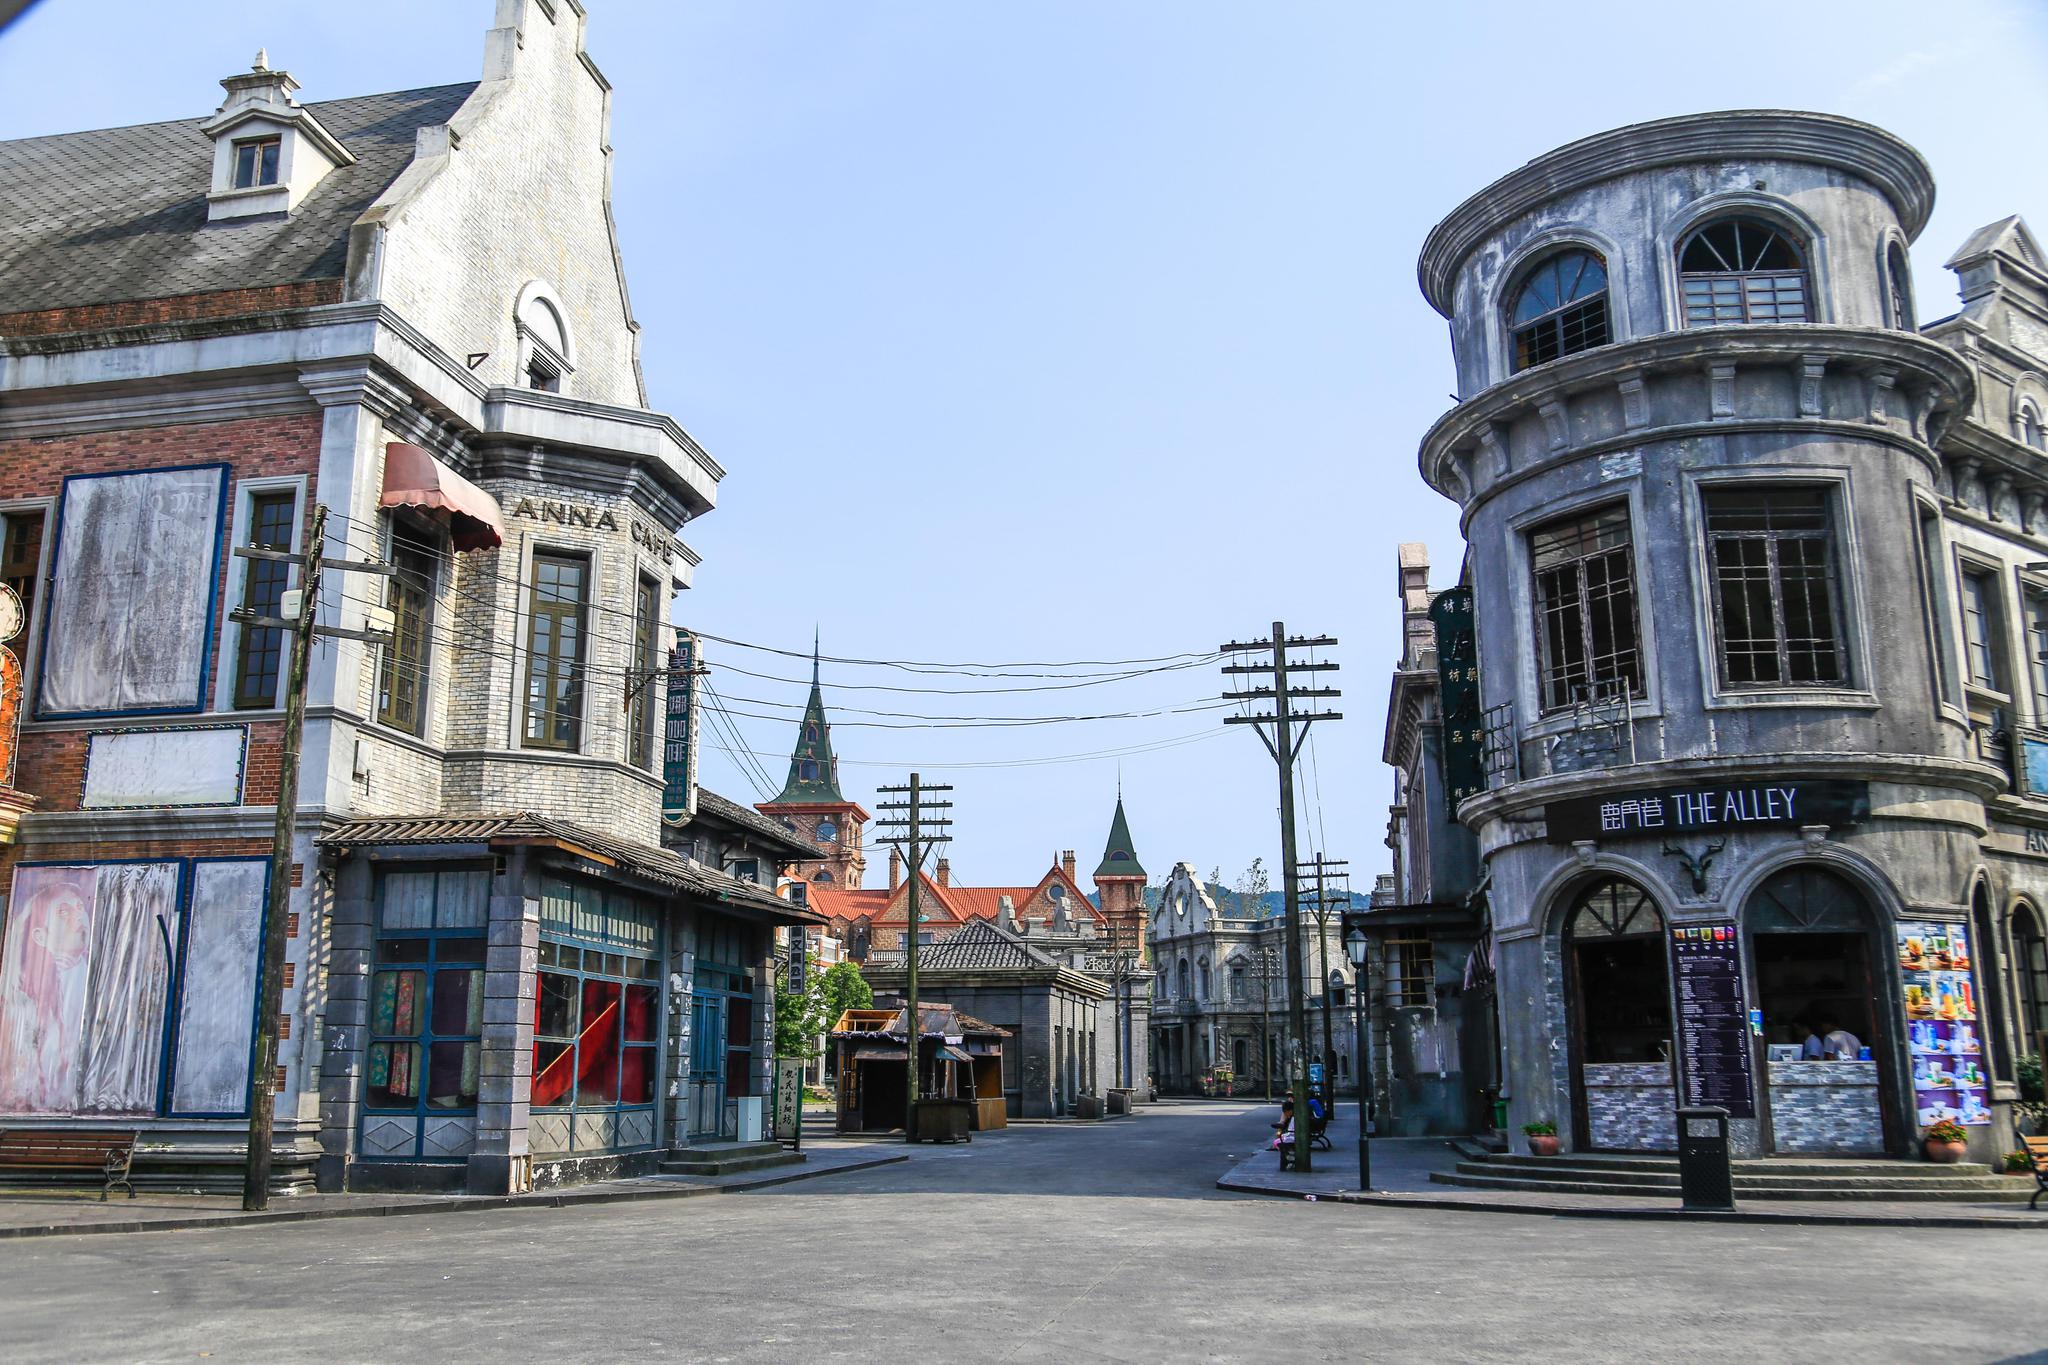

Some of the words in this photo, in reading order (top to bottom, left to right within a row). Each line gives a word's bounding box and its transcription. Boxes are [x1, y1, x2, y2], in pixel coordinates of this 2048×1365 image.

[512, 497, 619, 532] ANNA
[630, 519, 674, 566] CAFE
[1600, 797, 1664, 832] 鹿角巷
[1670, 792, 1718, 825] THE
[1723, 788, 1796, 822] ALLEY
